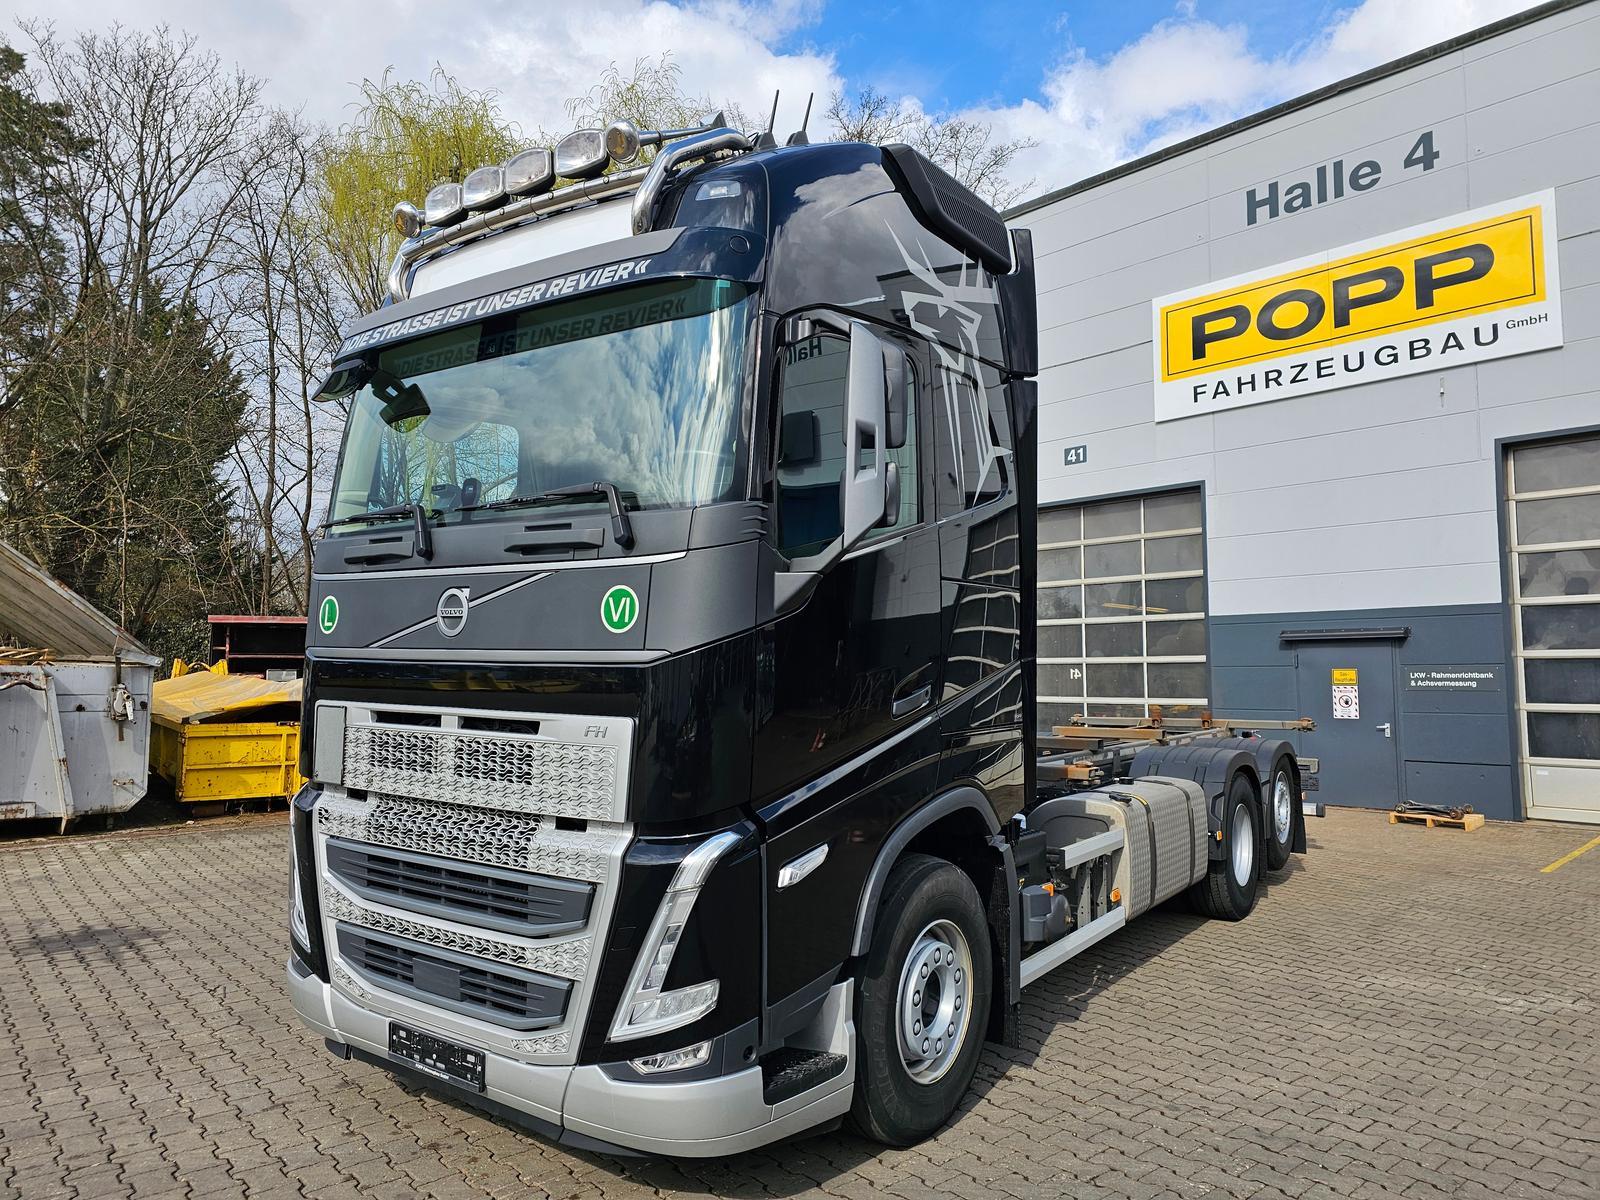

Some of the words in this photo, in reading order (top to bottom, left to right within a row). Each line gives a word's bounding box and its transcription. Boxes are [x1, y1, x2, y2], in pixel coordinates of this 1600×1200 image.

[1246, 159, 1382, 226] Halle
[1403, 130, 1440, 172] 4
[369, 309, 446, 344] STRASSE
[443, 300, 477, 324] IST
[475, 283, 546, 316] UNSER
[1192, 243, 1495, 361] POPP
[530, 318, 596, 346] UNSER
[1193, 323, 1500, 403] FAHRZEUGBAU
[1505, 313, 1549, 330] GmbH
[1067, 447, 1084, 463] 41
[324, 603, 333, 627] L
[608, 597, 631, 623] VI
[1417, 680, 1477, 688] Achsvermessung
[1431, 671, 1494, 679] Rahmenrichtbank
[584, 725, 608, 738] FH
